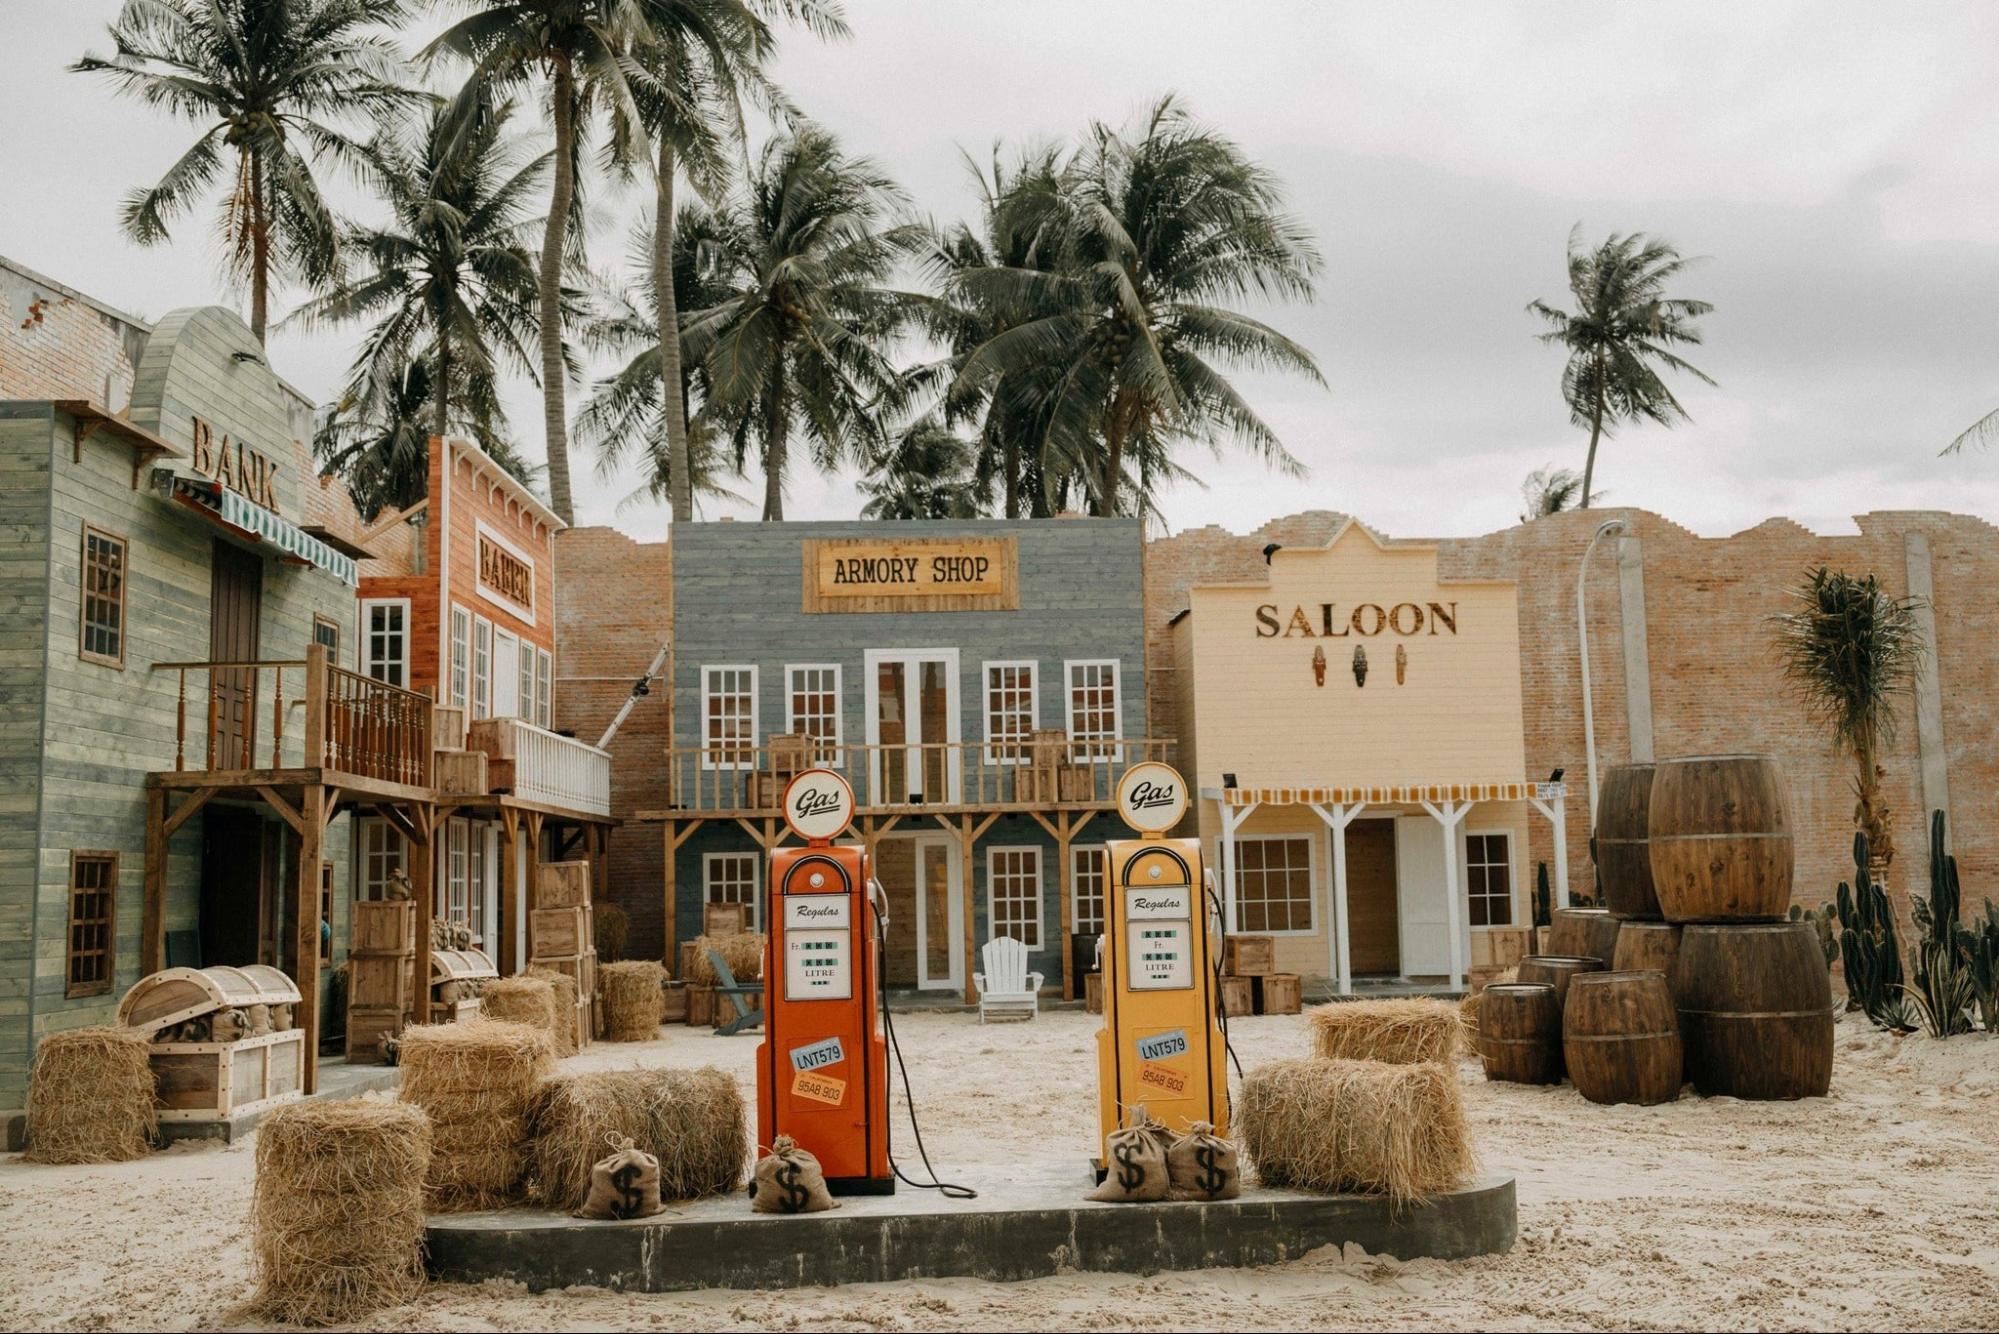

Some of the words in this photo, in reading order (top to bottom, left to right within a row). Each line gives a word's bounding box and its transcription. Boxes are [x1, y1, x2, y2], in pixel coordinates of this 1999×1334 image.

[192, 415, 280, 515] BANK
[834, 558, 919, 584] ARMORY
[933, 556, 989, 582] SHOP
[1256, 602, 1458, 638] SALOON
[796, 788, 840, 819] Gas
[1130, 781, 1174, 811] Gas
[805, 969, 835, 977] LITRE
[1145, 963, 1175, 971] LITRE
[796, 1045, 841, 1070] LNT579
[1142, 1037, 1186, 1060] LNT579
[822, 1086, 841, 1100] 903
[1166, 1077, 1185, 1092] 903
